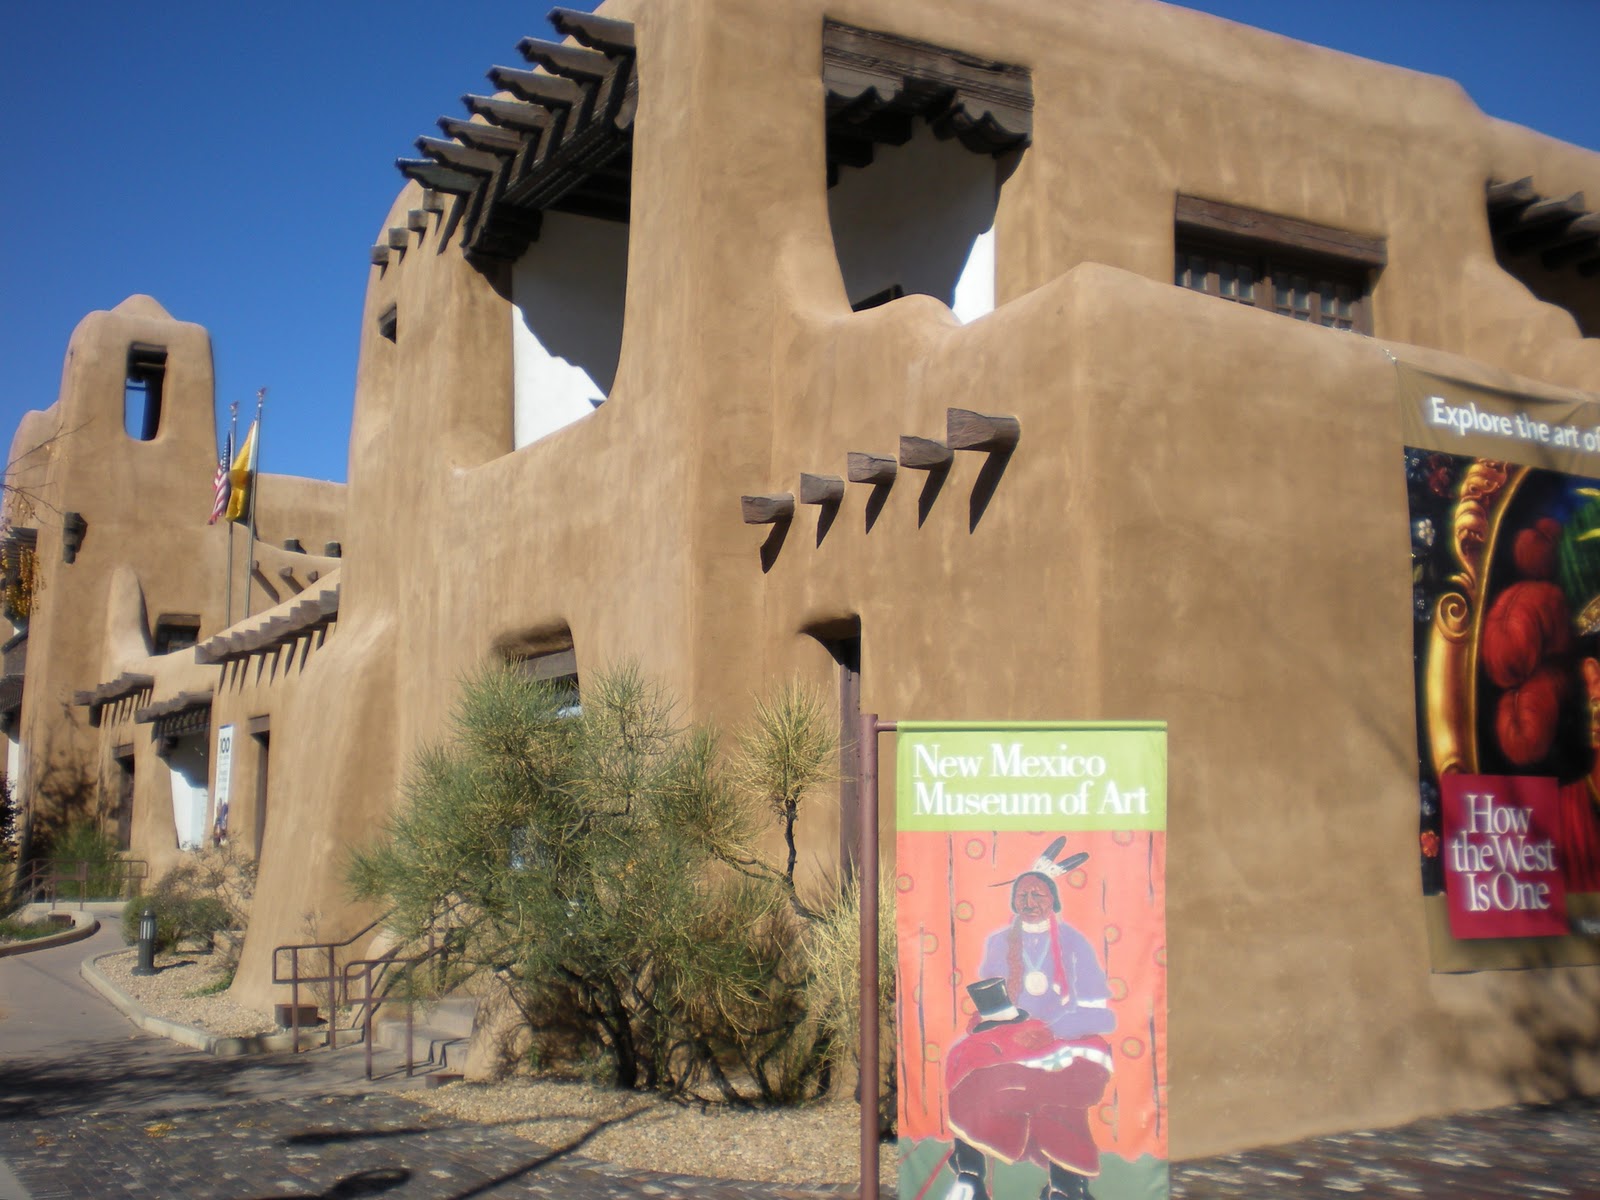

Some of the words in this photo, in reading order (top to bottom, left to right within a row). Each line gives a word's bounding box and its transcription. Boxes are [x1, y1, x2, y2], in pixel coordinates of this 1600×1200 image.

[1431, 397, 1513, 436] Explore
[1516, 414, 1550, 442] the
[1554, 425, 1579, 448] art
[220, 737, 231, 754] 100
[913, 744, 983, 778] New
[990, 743, 1106, 778] Mexico
[913, 781, 1052, 816] Museum
[1059, 780, 1094, 816] of
[1098, 780, 1150, 815] Art
[1467, 794, 1533, 834] How
